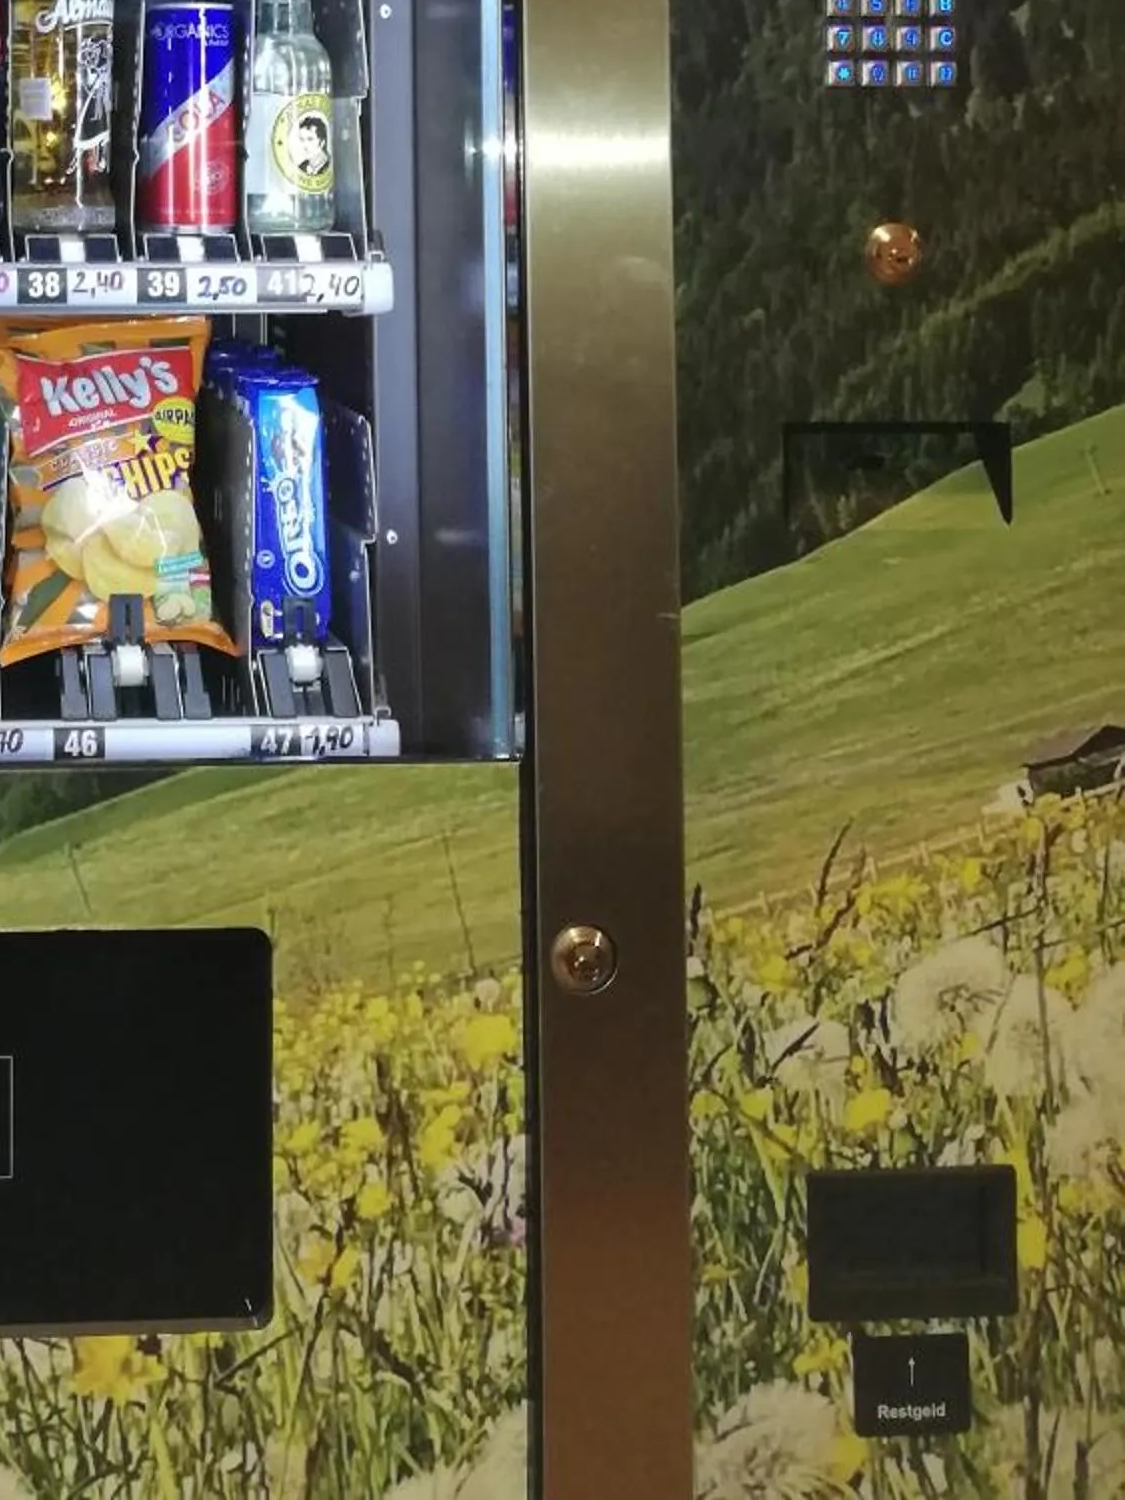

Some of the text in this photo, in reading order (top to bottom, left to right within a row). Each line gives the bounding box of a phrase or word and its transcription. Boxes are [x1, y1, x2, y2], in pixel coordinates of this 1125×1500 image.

[28, 271, 61, 298] 38
[147, 271, 248, 301] 39 2,50
[266, 271, 298, 296] 41
[40, 356, 179, 416] Kelly's
[64, 728, 98, 756] 46
[260, 727, 293, 756] 47
[877, 1402, 947, 1421] Restgeld
